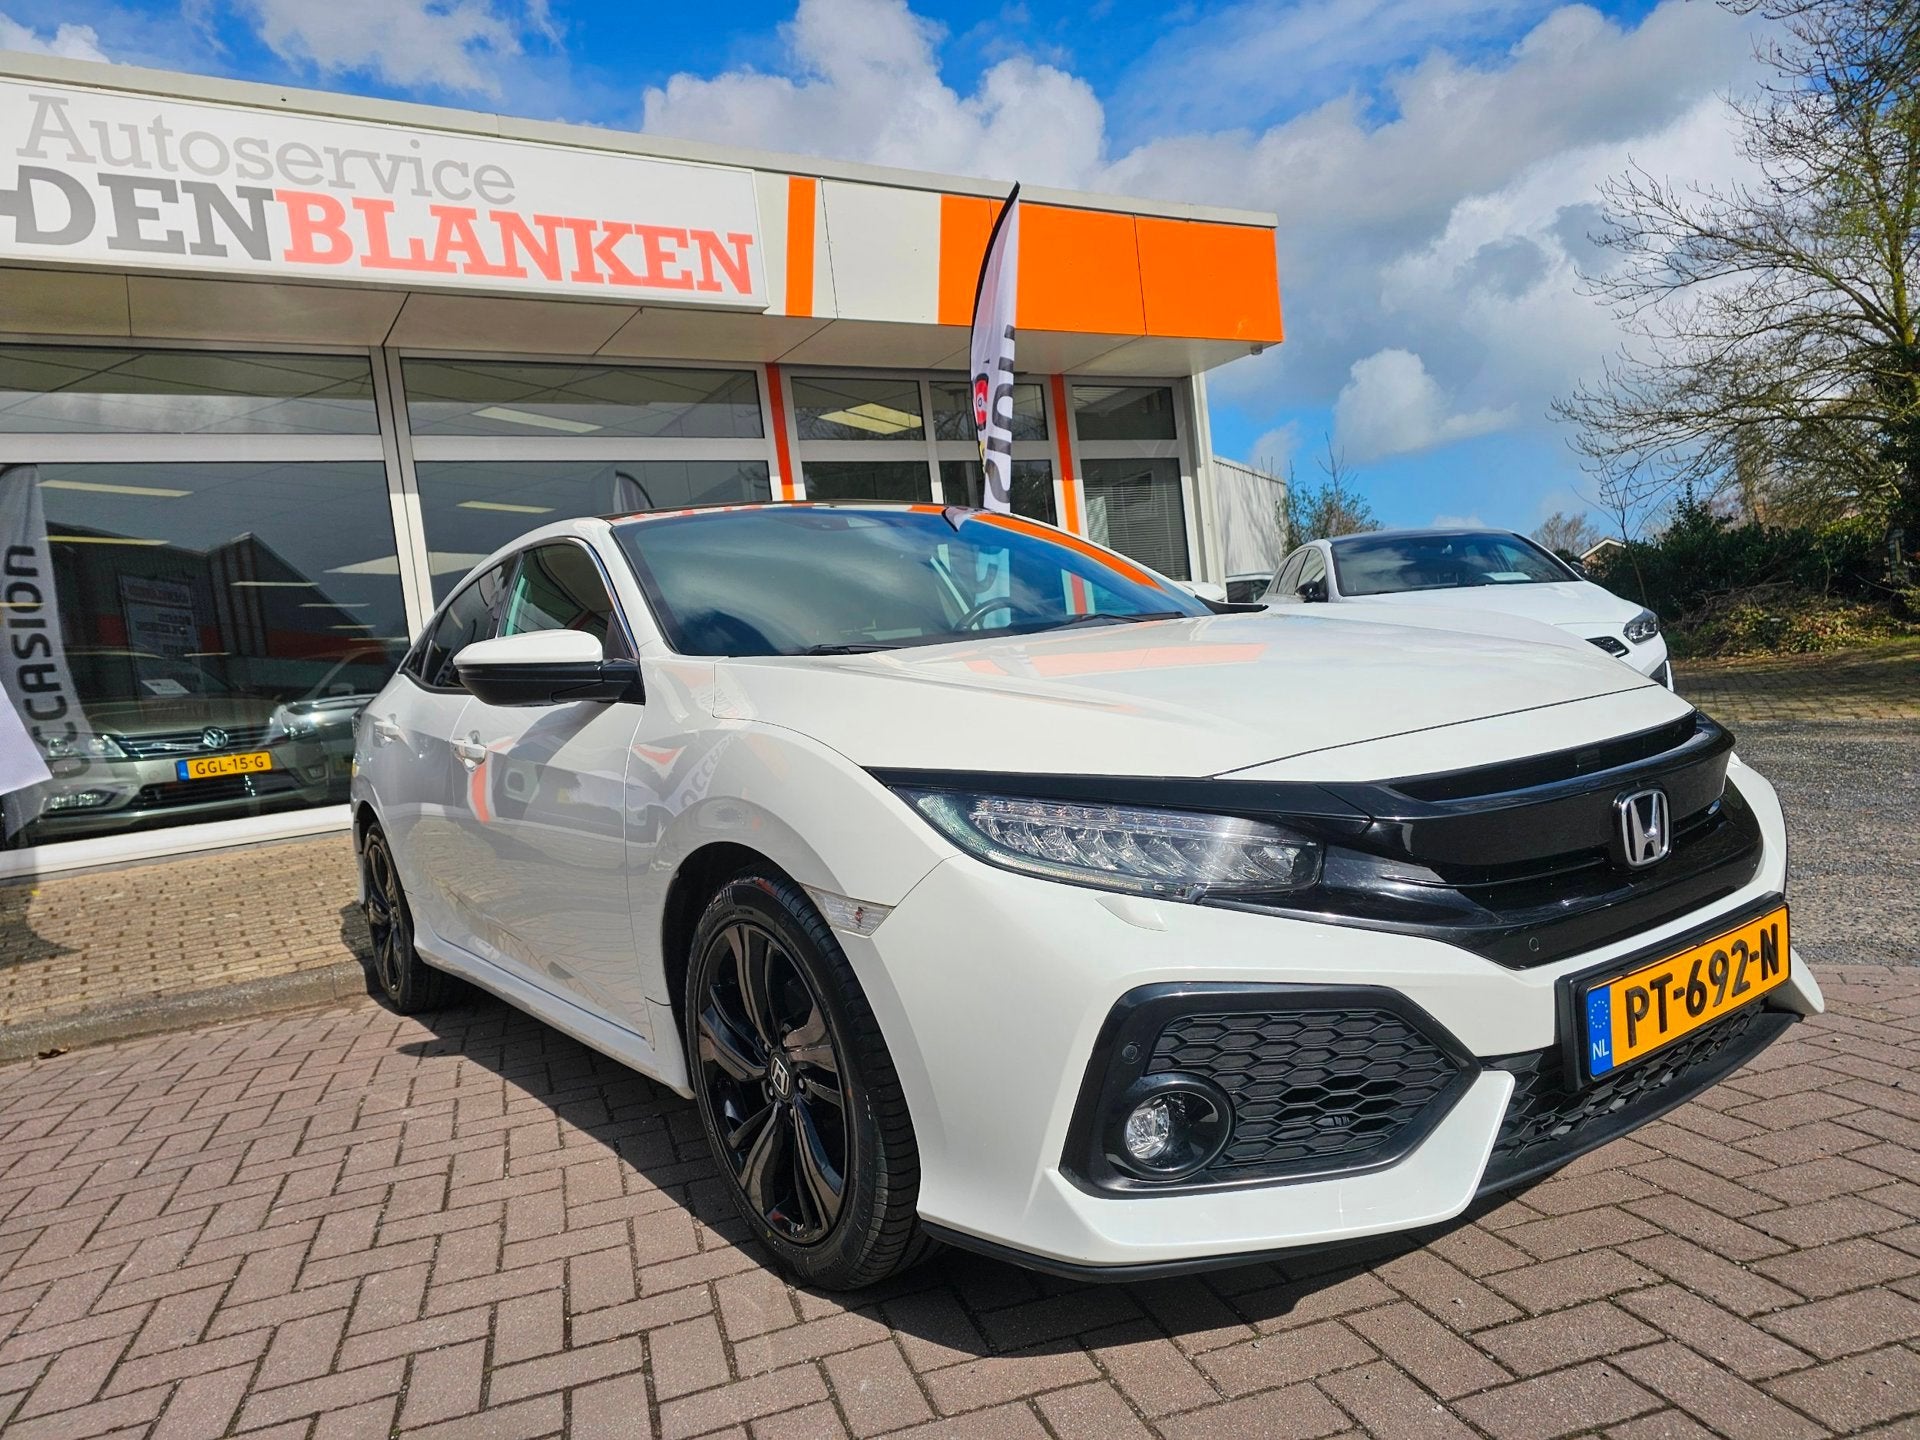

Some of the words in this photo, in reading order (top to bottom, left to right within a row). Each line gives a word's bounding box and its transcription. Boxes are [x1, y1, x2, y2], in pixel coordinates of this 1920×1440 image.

[15, 93, 517, 205] Autoservice
[195, 755, 264, 775] GGL-15-G
[1624, 922, 1780, 1049] PT-692-N
[1592, 1041, 1610, 1060] NL
